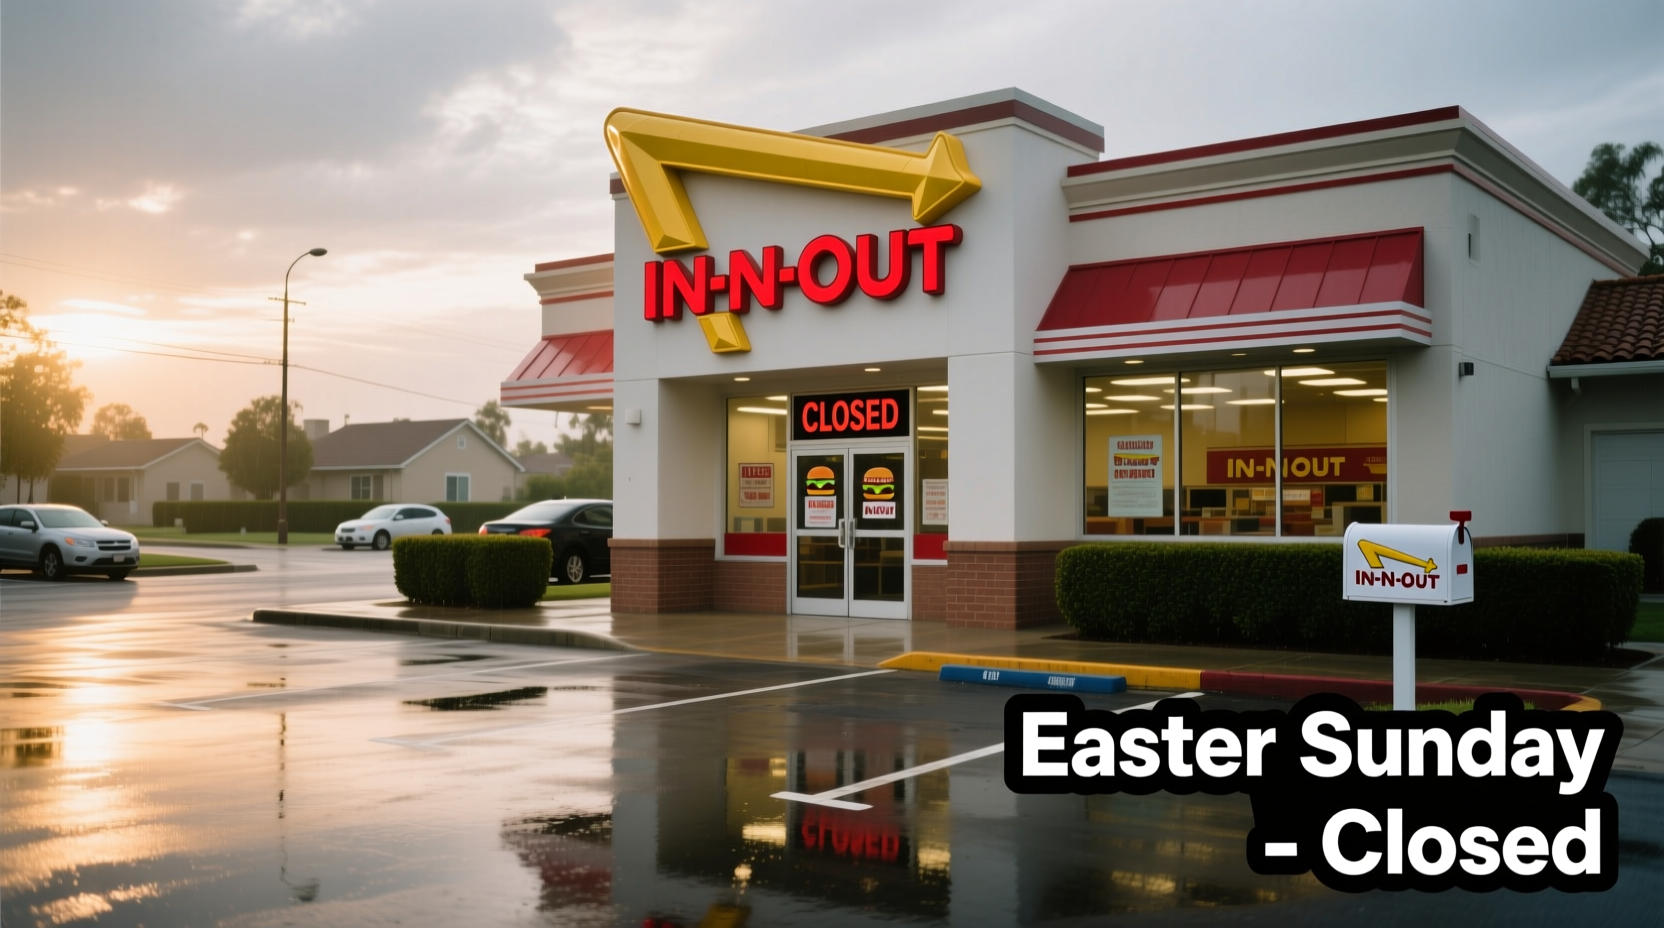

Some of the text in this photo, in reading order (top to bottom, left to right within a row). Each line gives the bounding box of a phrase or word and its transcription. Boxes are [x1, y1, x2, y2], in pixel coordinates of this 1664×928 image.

[644, 224, 963, 322] IN-N-OUT
[802, 398, 899, 433] CLOSED
[1355, 570, 1440, 589] IN-N-OUT
